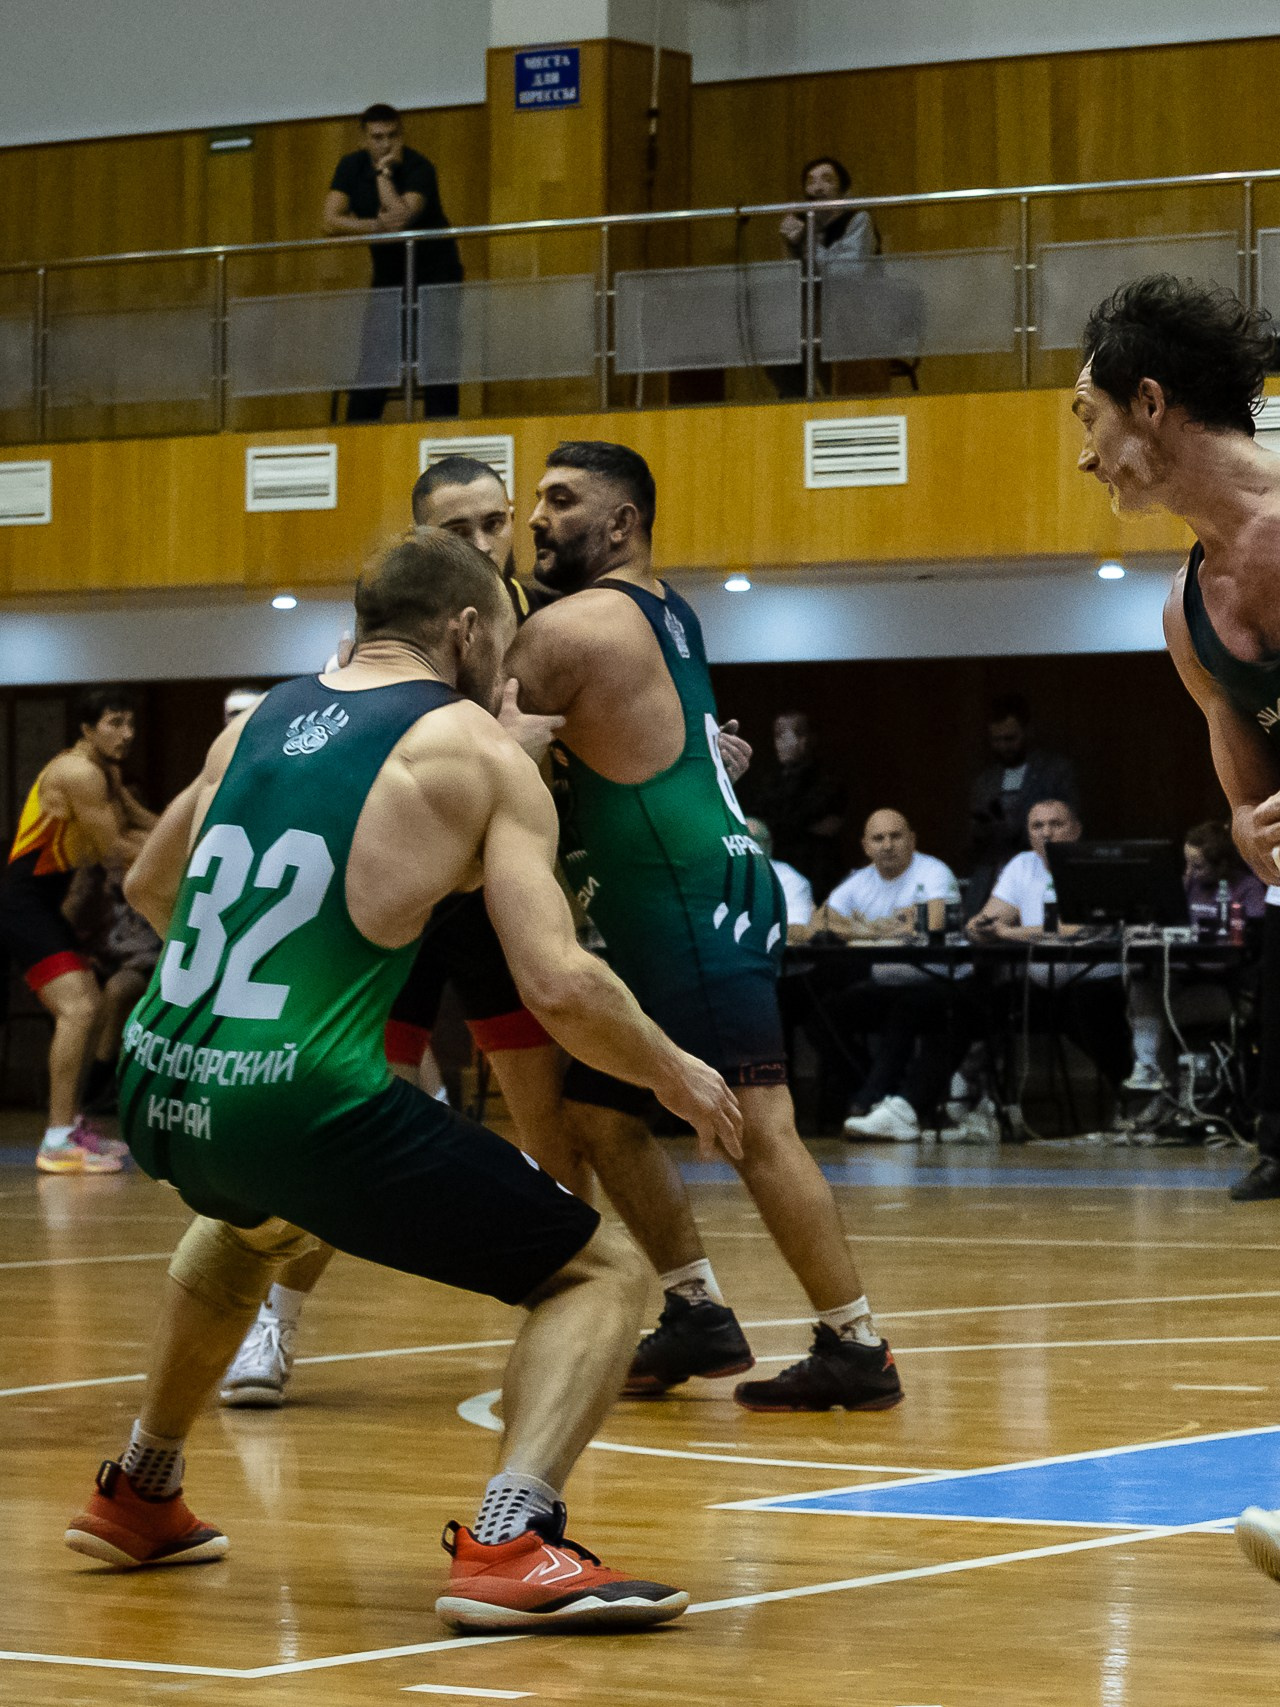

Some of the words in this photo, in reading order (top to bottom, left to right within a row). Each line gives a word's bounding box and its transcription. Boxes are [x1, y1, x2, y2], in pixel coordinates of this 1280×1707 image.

[721, 834, 763, 857] КРА
[160, 824, 335, 1020] 32
[147, 1094, 211, 1141] КРАЙ
